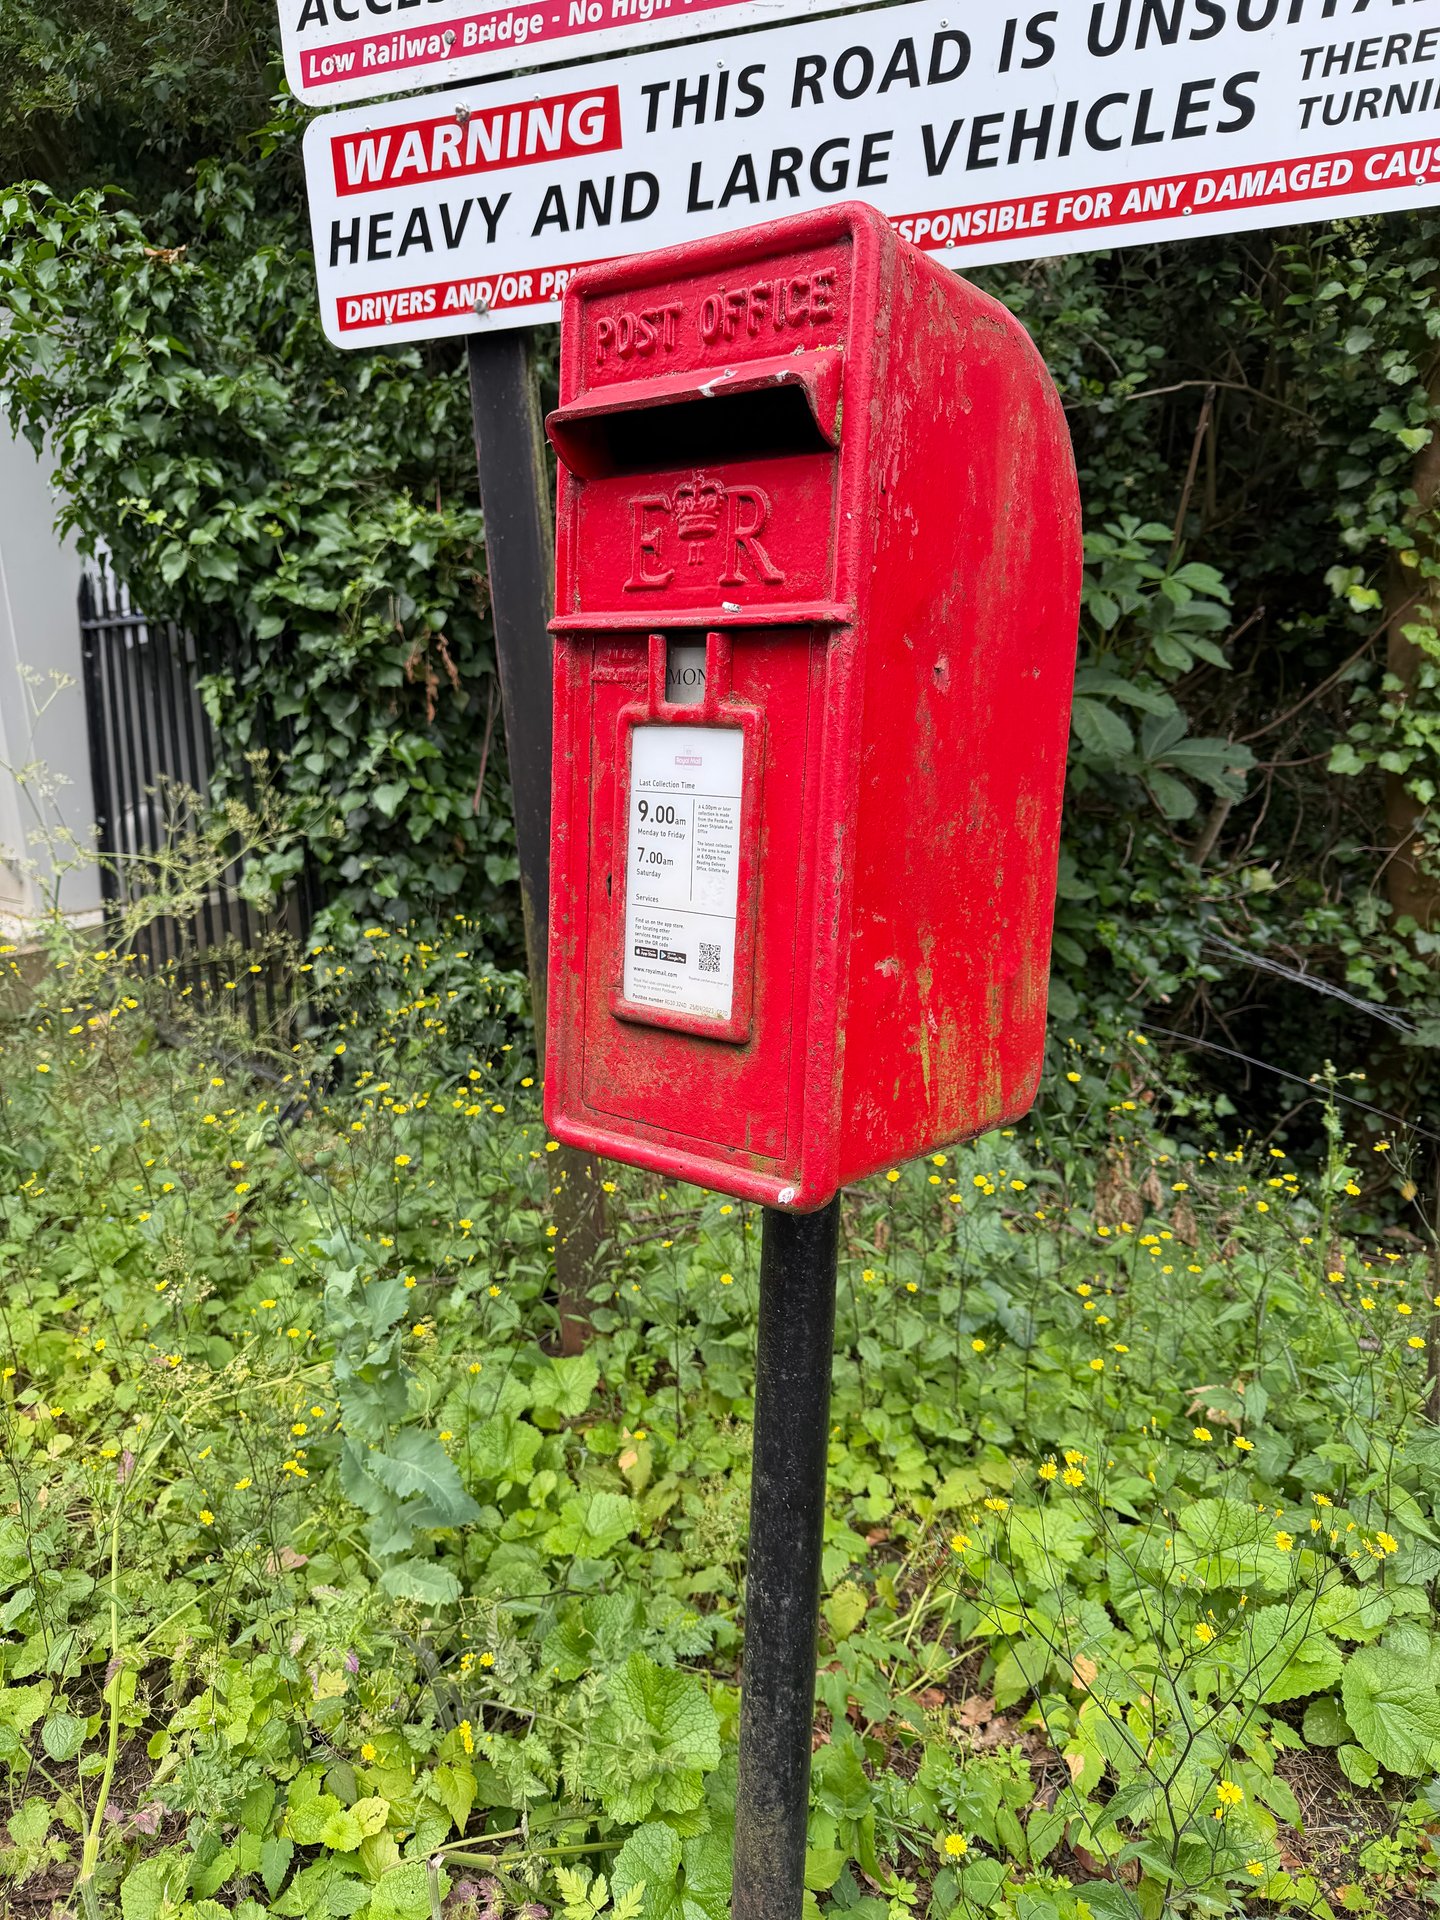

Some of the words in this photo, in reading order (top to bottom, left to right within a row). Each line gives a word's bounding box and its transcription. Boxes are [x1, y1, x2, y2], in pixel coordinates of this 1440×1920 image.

[309, 50, 355, 79] Low
[362, 33, 456, 68] Railway
[462, 11, 543, 47] Bridge
[568, 1, 603, 27] No
[1300, 27, 1440, 81] THERE
[343, 96, 606, 186] WARNING
[641, 63, 766, 134] THIS
[791, 29, 971, 109] ROAD
[997, 11, 1058, 74] IS
[1299, 78, 1440, 131] TURNI
[329, 192, 512, 267] HEAVY
[531, 171, 659, 237] AND
[686, 130, 893, 213] LARGE
[920, 71, 1261, 178] VEHICLES
[890, 201, 1049, 244] SPONSIBLE
[1055, 192, 1114, 224] FOR
[1120, 181, 1188, 217] ANY
[1192, 159, 1354, 207] DAMAGED
[345, 288, 436, 325] DRIVERS
[442, 274, 533, 310] AND/OR
[594, 301, 683, 364] POST
[700, 267, 837, 343] OFFICE
[639, 779, 651, 787] Last
[653, 780, 680, 788] Collection
[681, 782, 695, 790] Time
[637, 828, 659, 838] Monday
[668, 831, 686, 841] Friday
[638, 800, 686, 826] 9.00am
[636, 868, 661, 879] Saturday
[637, 847, 674, 866] 7.00am
[635, 893, 659, 903] Services
[632, 966, 678, 978] www.royalmail.com
